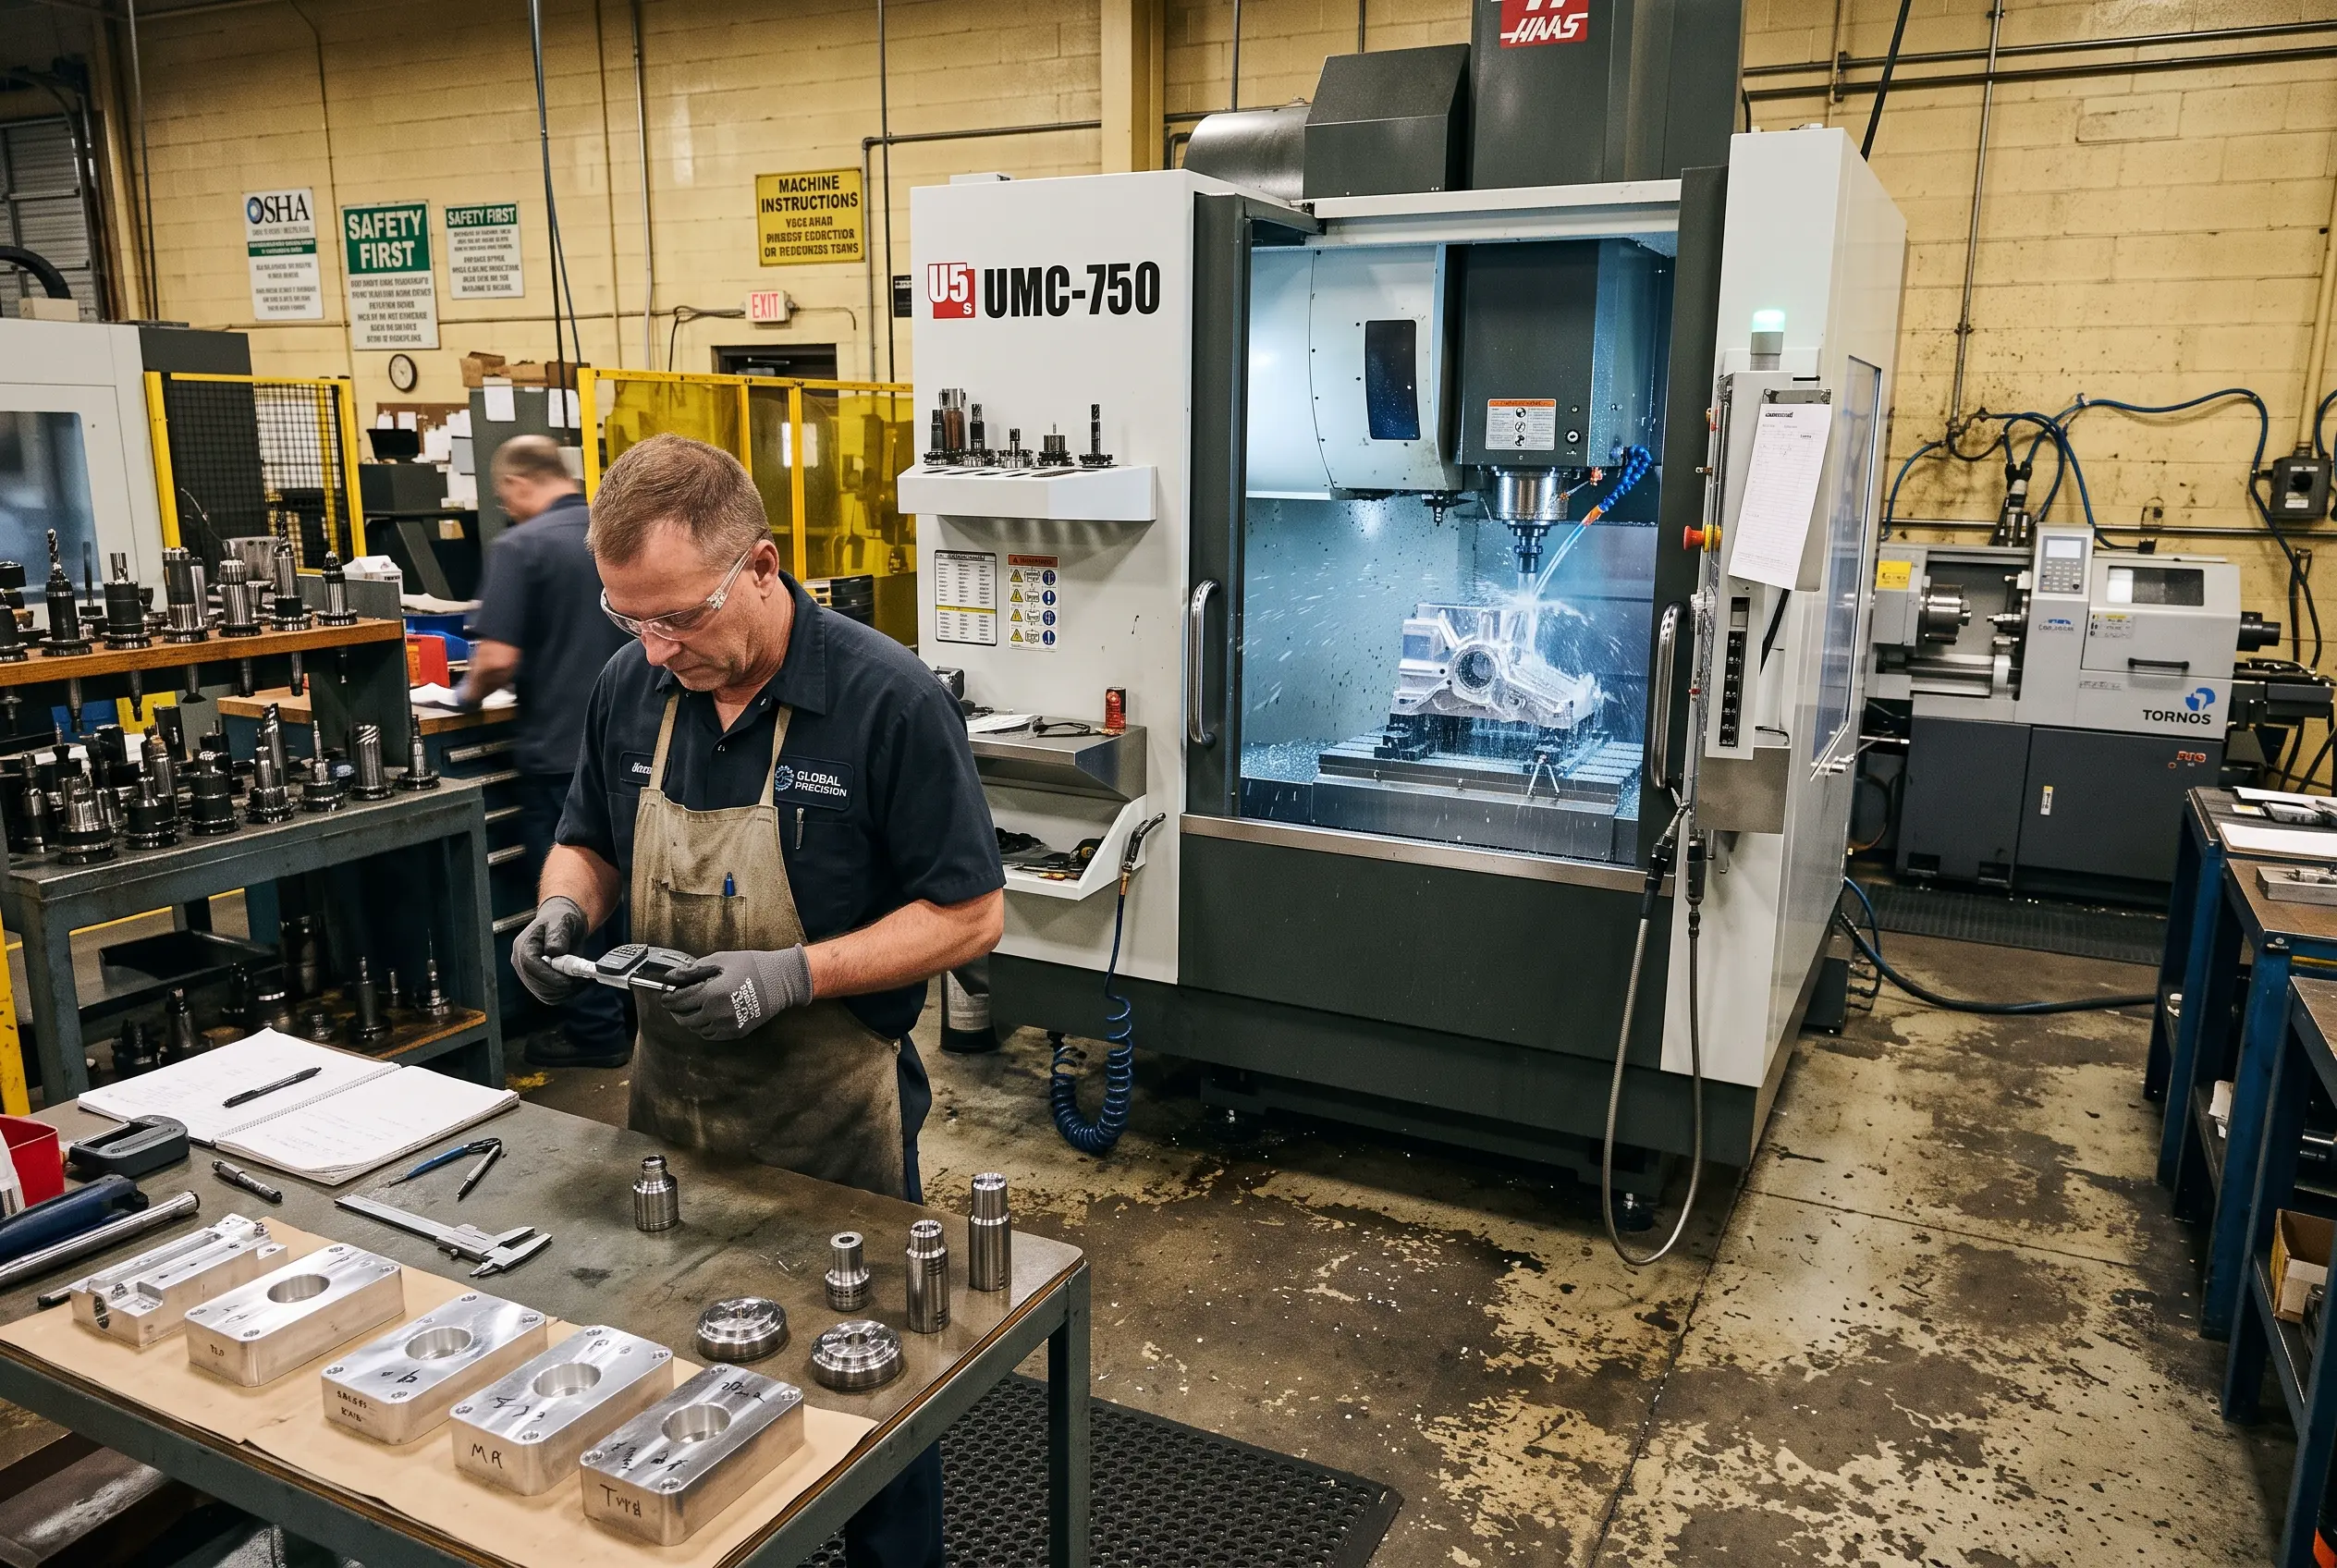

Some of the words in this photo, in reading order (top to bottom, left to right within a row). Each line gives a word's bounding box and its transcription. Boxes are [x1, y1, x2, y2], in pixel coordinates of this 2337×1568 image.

[1500, 12, 1588, 43] HAAS
[778, 175, 839, 193] MACHINE
[247, 193, 311, 225] OSHA
[761, 192, 859, 213] INSTRUCTIONS
[348, 210, 422, 240] SAFETY
[447, 209, 484, 226] SAFETY
[486, 207, 515, 223] FIRST
[360, 240, 415, 269] FIRST
[765, 247, 777, 258] OR
[984, 261, 1159, 318] UMC-750
[752, 293, 778, 319] EXIT
[2142, 709, 2211, 725] TORNOS
[795, 781, 847, 797] PRECISION
[796, 770, 841, 787] GLOBAL
